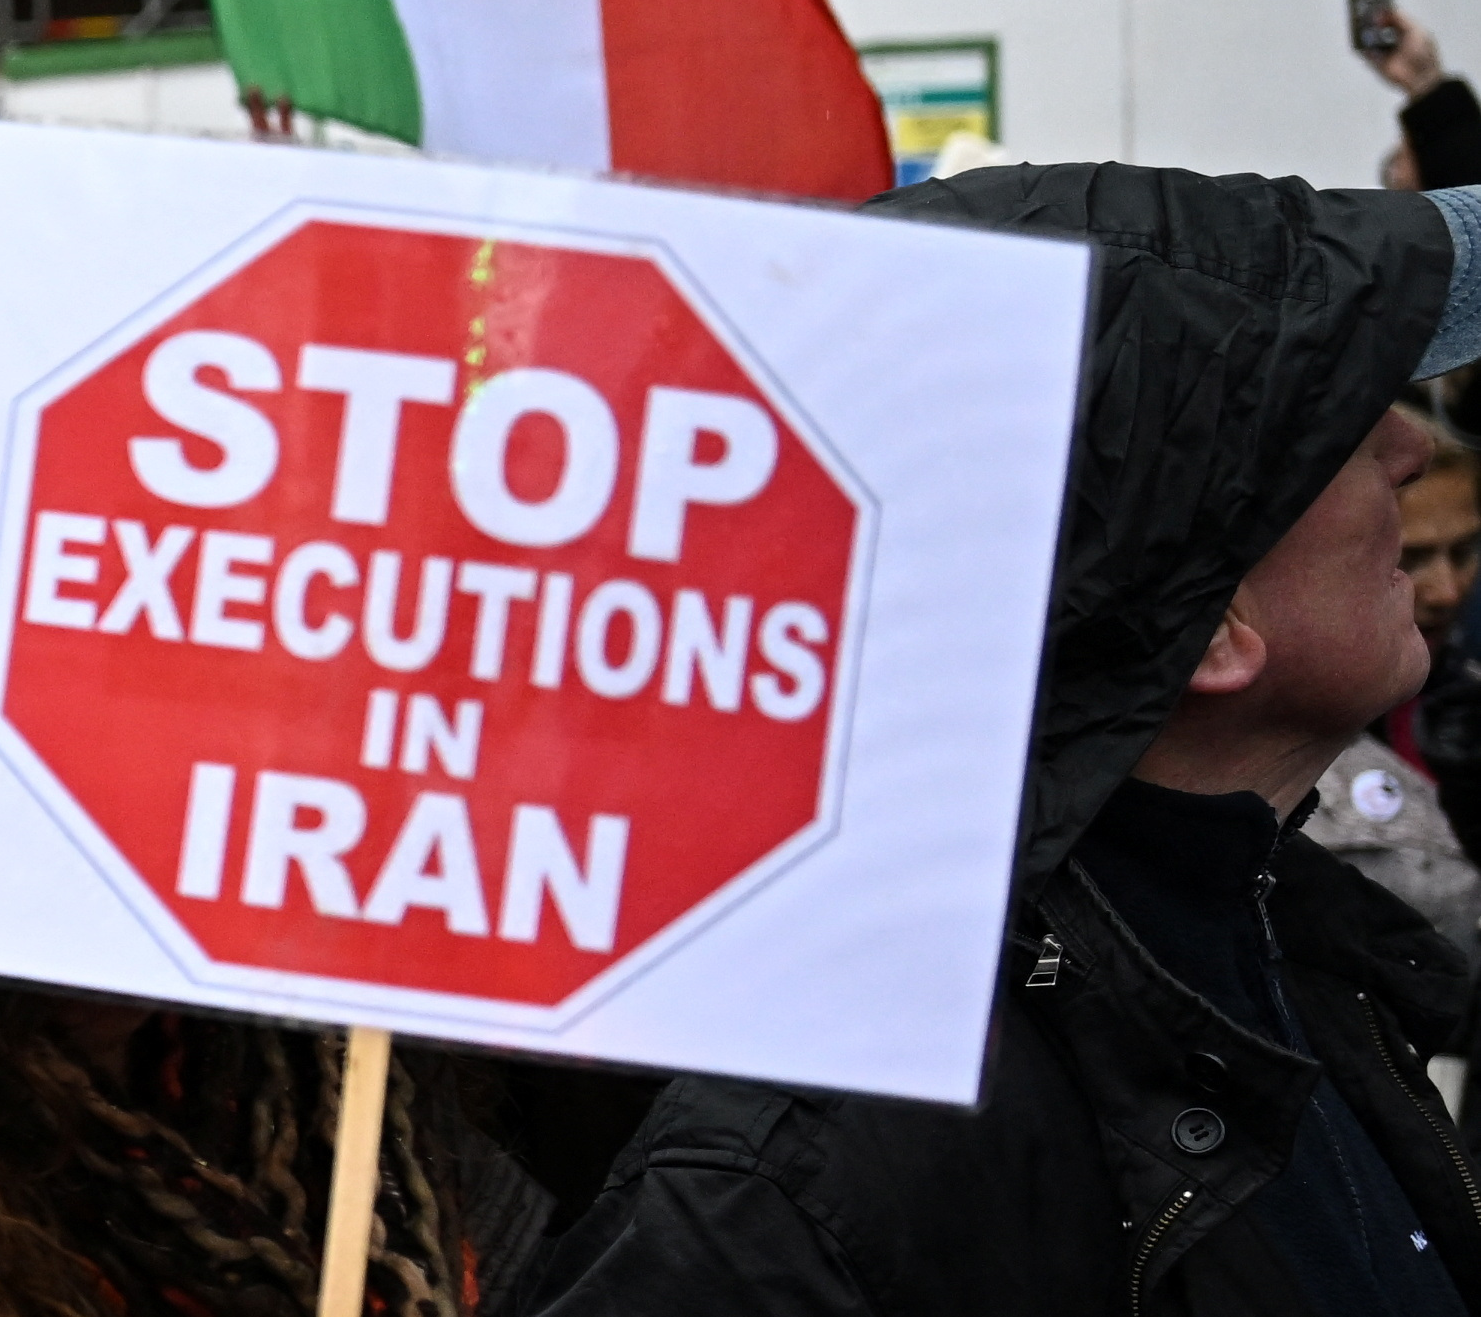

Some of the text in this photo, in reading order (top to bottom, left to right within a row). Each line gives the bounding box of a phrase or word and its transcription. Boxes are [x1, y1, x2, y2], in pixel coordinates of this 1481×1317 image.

[127, 330, 779, 563] STOP
[23, 510, 829, 722] EXECUTIONS
[361, 689, 484, 780] IN
[177, 762, 630, 955] IRAN
